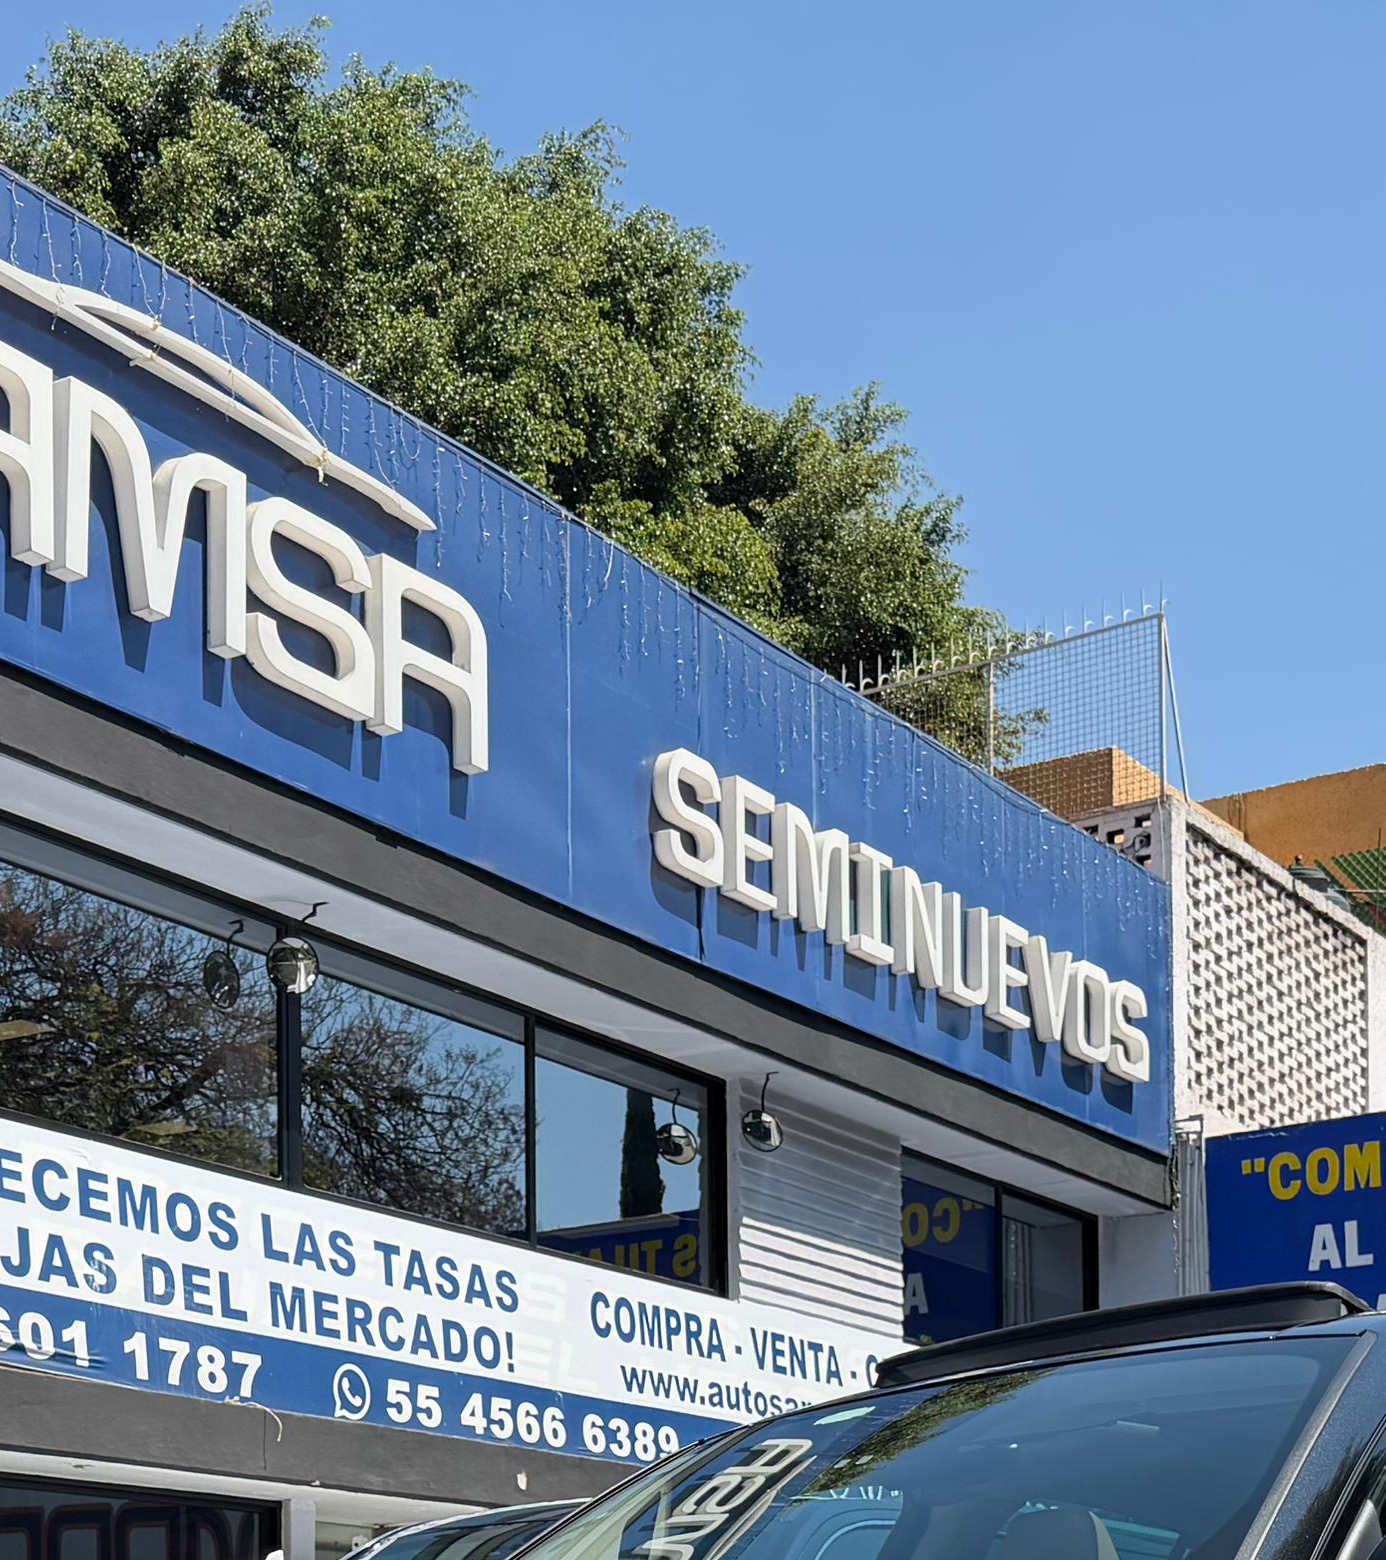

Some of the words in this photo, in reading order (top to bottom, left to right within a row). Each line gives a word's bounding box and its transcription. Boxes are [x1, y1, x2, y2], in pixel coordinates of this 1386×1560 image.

[653, 747, 1150, 1084] SEMINUEVOS
[261, 1213, 357, 1277] LAS
[374, 1241, 519, 1312] TASAS
[1308, 1223, 1373, 1272] AL
[142, 1253, 248, 1322] DEL
[269, 1281, 517, 1373] MERCADO!
[590, 1291, 727, 1362] COMPRA
[749, 1327, 844, 1387] VENTA
[123, 1330, 264, 1398] 1787
[620, 1365, 812, 1417] www.autosa
[385, 1380, 444, 1430] 55
[460, 1393, 568, 1448] 4566
[582, 1414, 680, 1462] 6389
